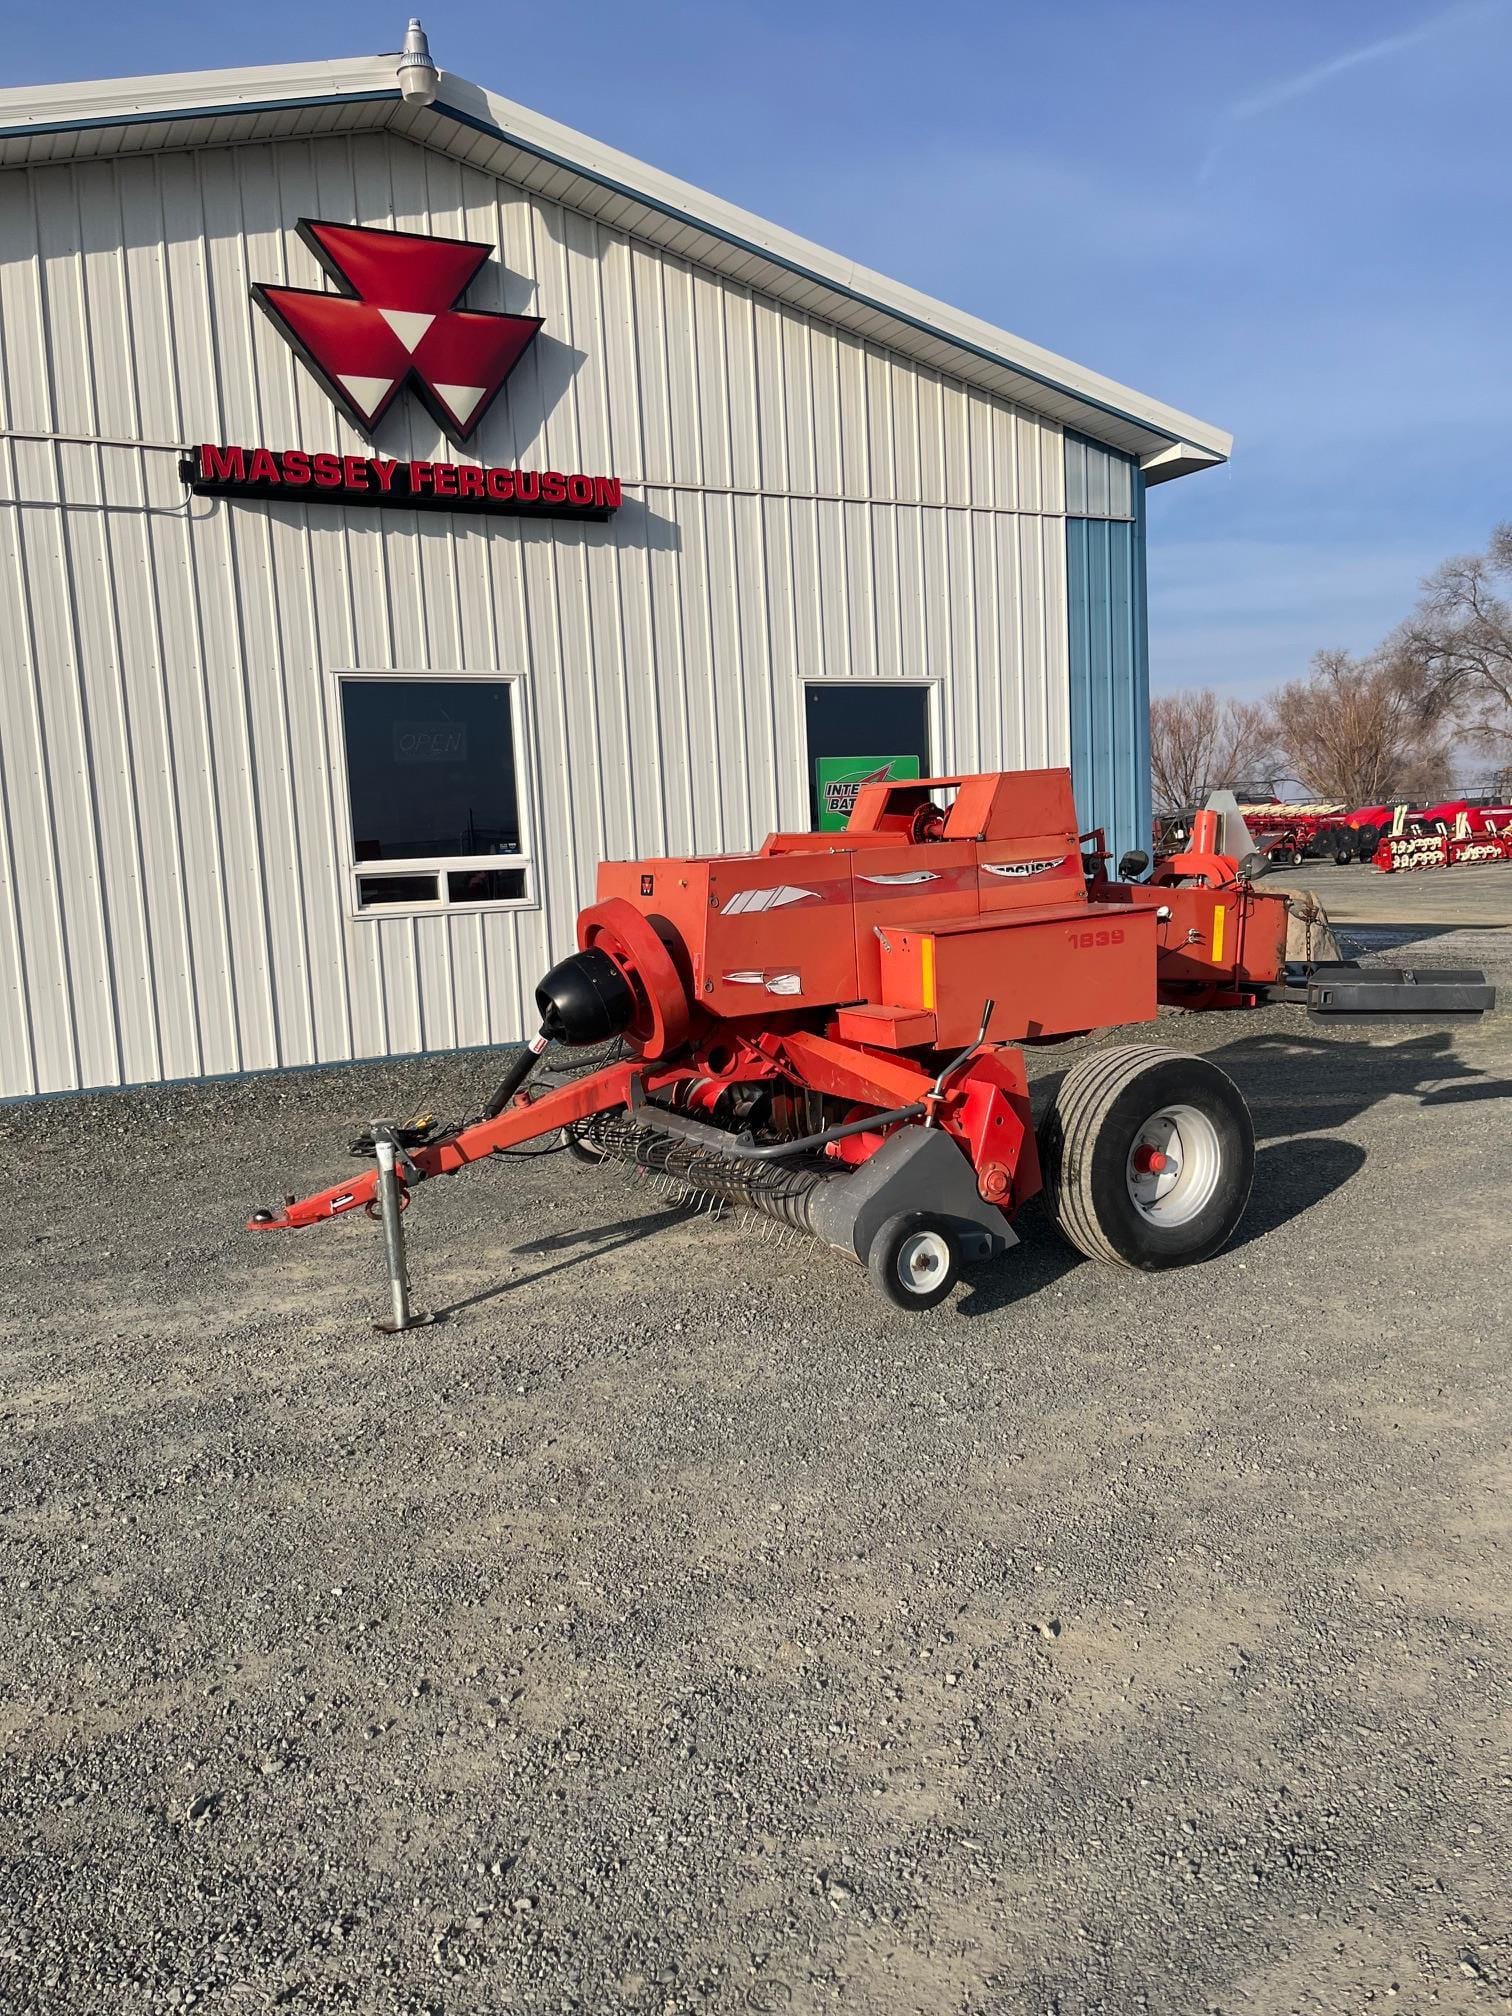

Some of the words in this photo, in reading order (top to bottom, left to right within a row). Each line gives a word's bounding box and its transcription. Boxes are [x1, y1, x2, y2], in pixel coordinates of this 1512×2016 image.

[201, 443, 397, 492] MASSEY
[410, 460, 622, 507] FERGUSON
[400, 732, 461, 751] OPEN
[1068, 929, 1125, 950] 1839
